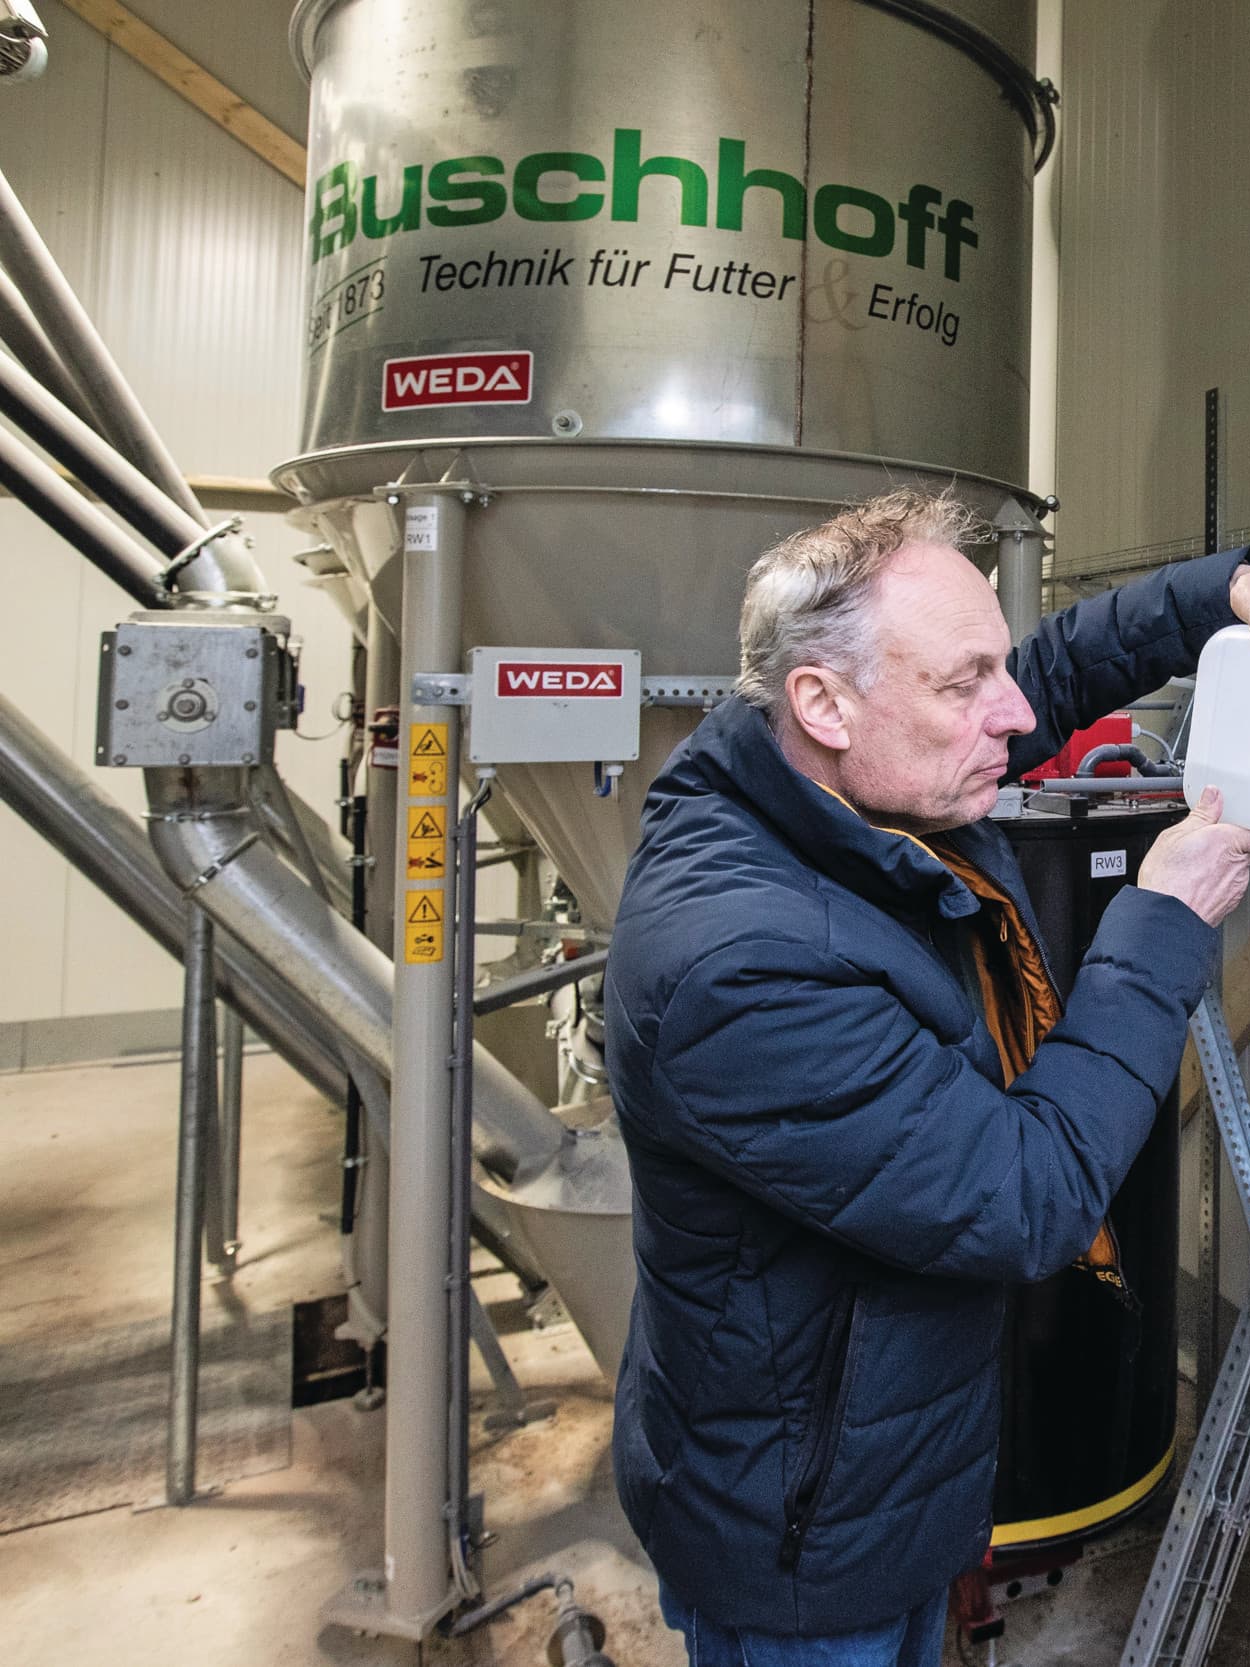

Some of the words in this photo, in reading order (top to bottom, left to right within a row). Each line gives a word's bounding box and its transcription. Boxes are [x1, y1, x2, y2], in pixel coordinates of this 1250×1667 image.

[310, 127, 979, 283] Buschhoff
[337, 269, 385, 321] 1873
[419, 248, 574, 293] Technik
[587, 249, 651, 287] für
[664, 253, 796, 301] Futter
[868, 283, 961, 347] Erfolg
[1095, 855, 1123, 870] RW3
